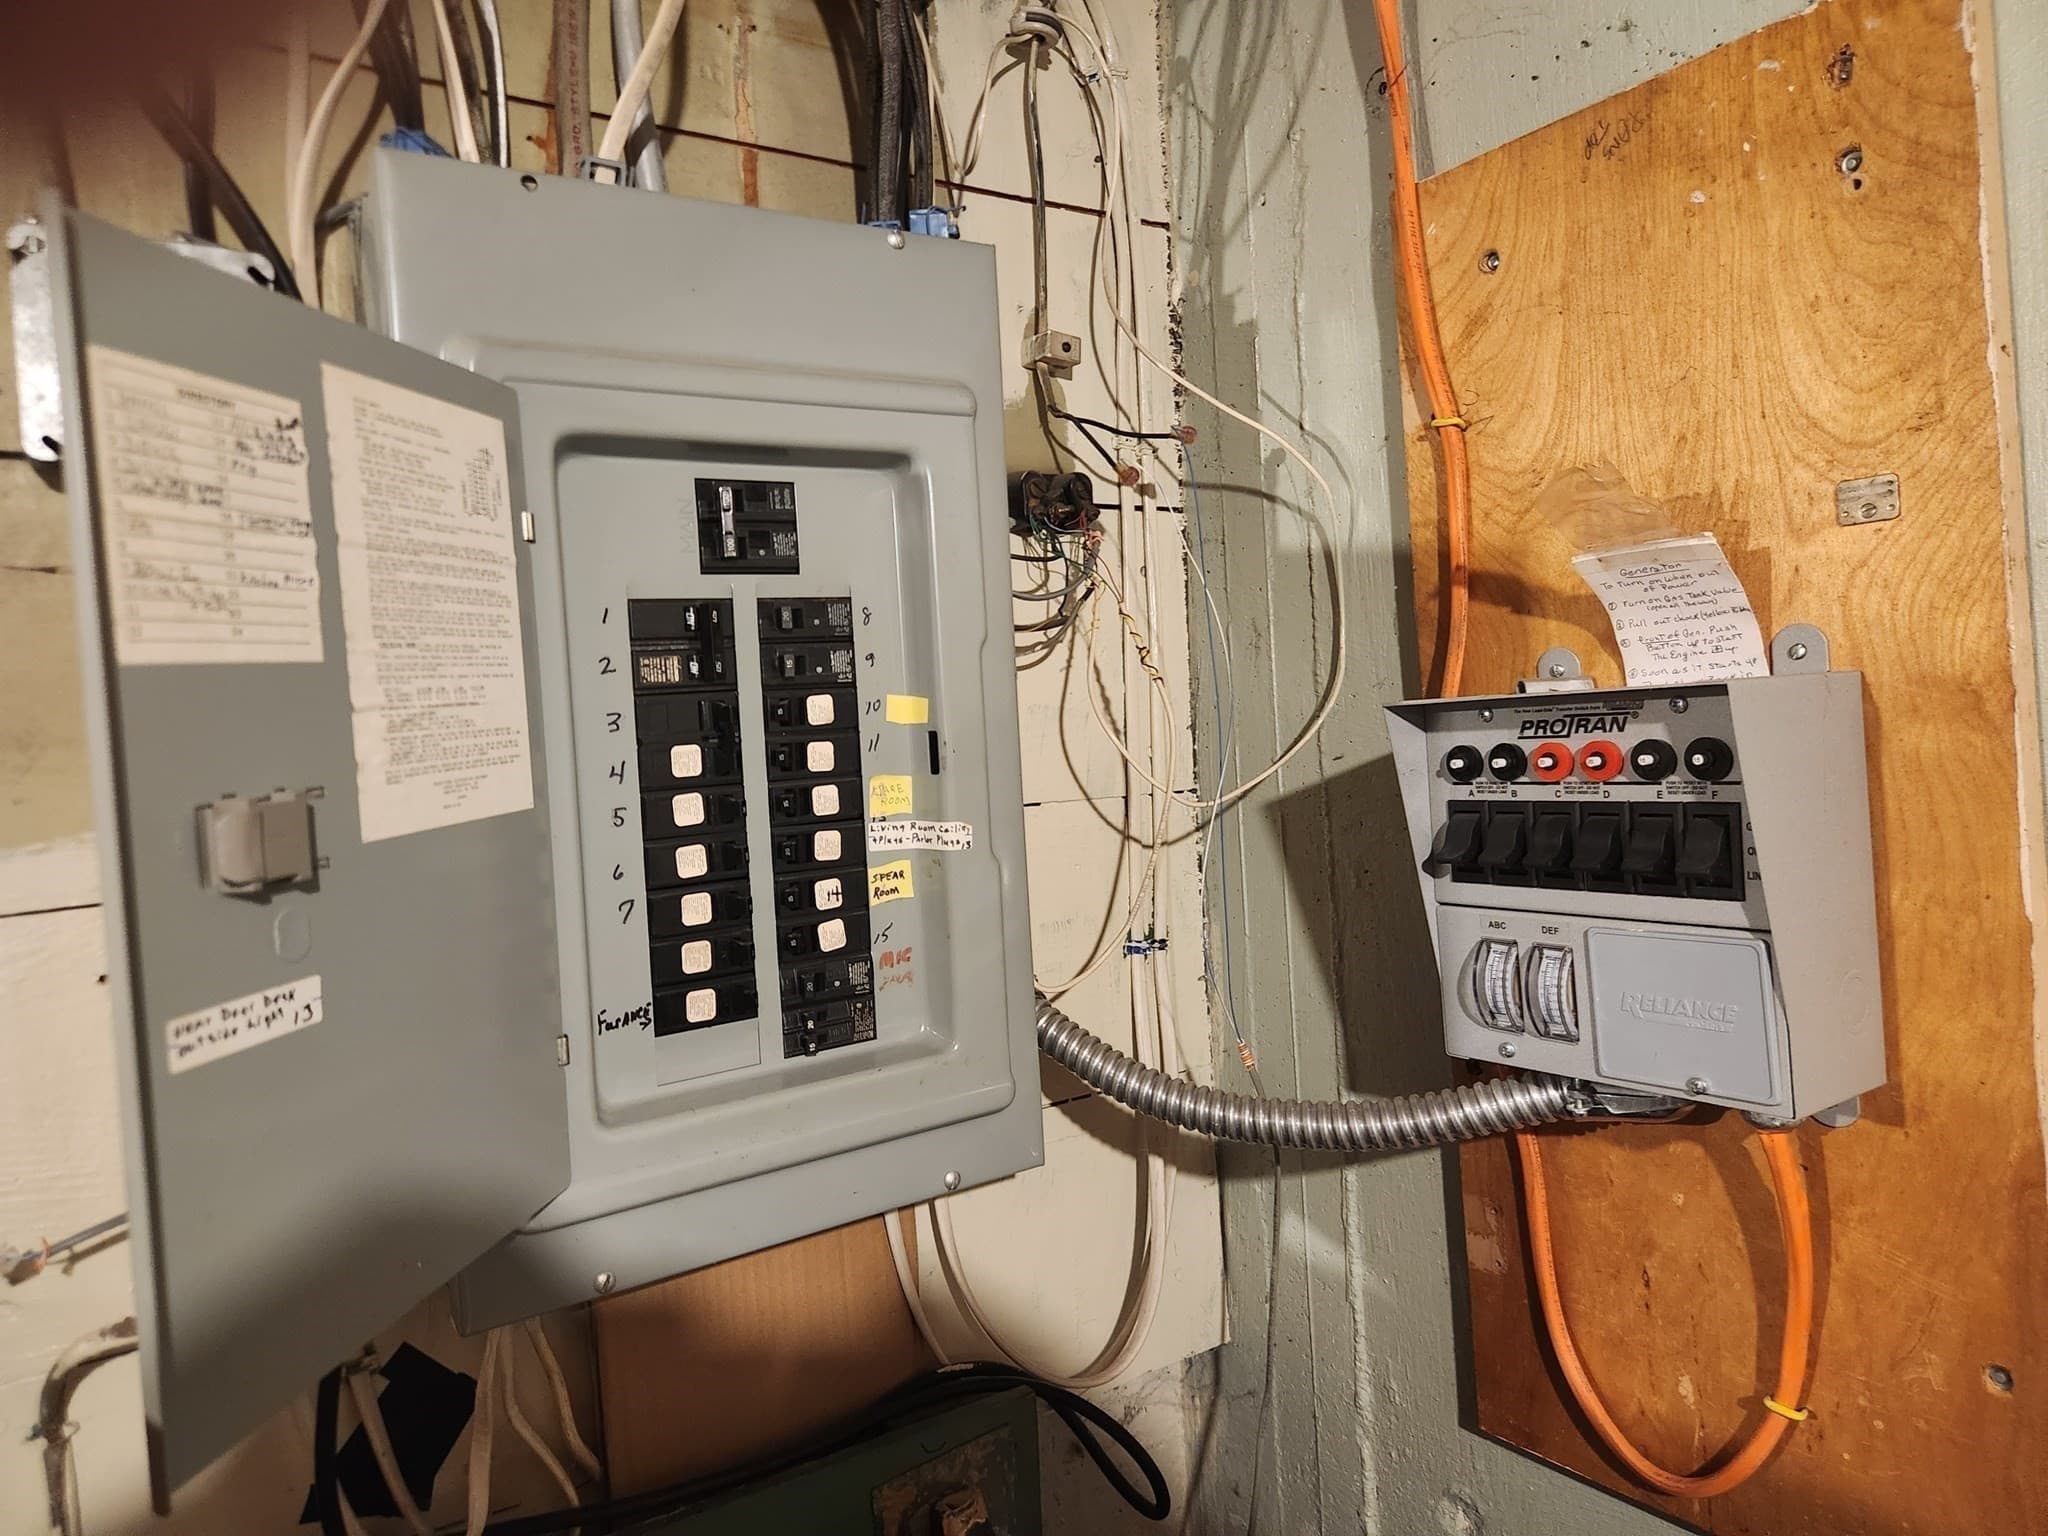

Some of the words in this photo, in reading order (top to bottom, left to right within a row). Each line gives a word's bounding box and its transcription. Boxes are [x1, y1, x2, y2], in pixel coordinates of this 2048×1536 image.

[727, 539, 735, 552] 100
[602, 608, 608, 623] 1
[862, 607, 872, 625] 8
[599, 658, 616, 675] 2
[865, 653, 874, 667] 9
[866, 699, 881, 715] 10
[607, 712, 622, 733] 3
[1518, 711, 1631, 739] PROTRAN
[609, 761, 625, 784] 4
[1468, 790, 1475, 798] A
[1511, 790, 1518, 798] B
[1554, 790, 1562, 798] C
[1603, 790, 1610, 799] D
[1657, 791, 1663, 799] E
[1711, 791, 1718, 799] F
[612, 807, 627, 827] 5
[612, 864, 625, 880] 6
[871, 870, 905, 884] SPEAR
[1747, 871, 1761, 880] LIN
[827, 886, 843, 902] 14
[618, 900, 635, 925] 7
[1488, 920, 1507, 930] ABC
[1541, 926, 1560, 936] DEF
[874, 922, 894, 944] 15
[1620, 991, 1738, 1025] RELIANCE
